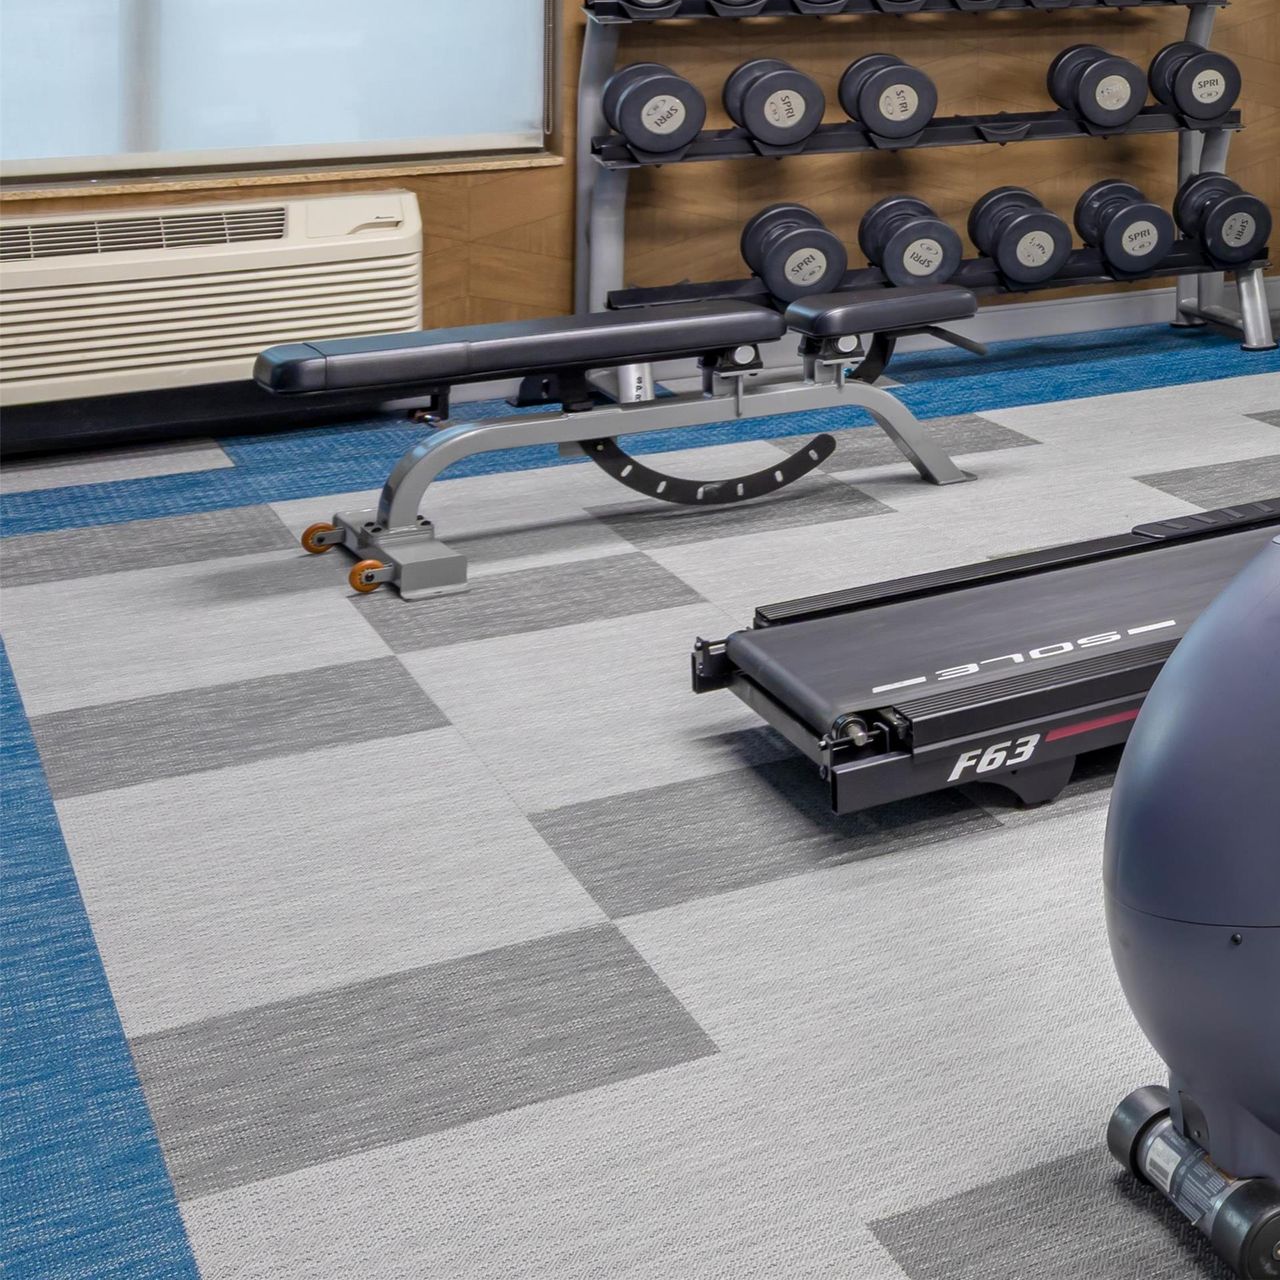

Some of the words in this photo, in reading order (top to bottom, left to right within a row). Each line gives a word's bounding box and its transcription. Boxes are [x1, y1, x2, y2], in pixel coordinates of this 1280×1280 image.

[1198, 78, 1219, 89] SPRI
[654, 105, 679, 127] SPRI
[781, 95, 796, 119] SPRI
[1128, 228, 1151, 243] SPRI
[1234, 219, 1249, 240] SPRI
[791, 254, 816, 275] SPRI
[910, 251, 933, 268] SPRI
[935, 631, 1122, 680] SOLE
[947, 733, 1041, 782] F63
